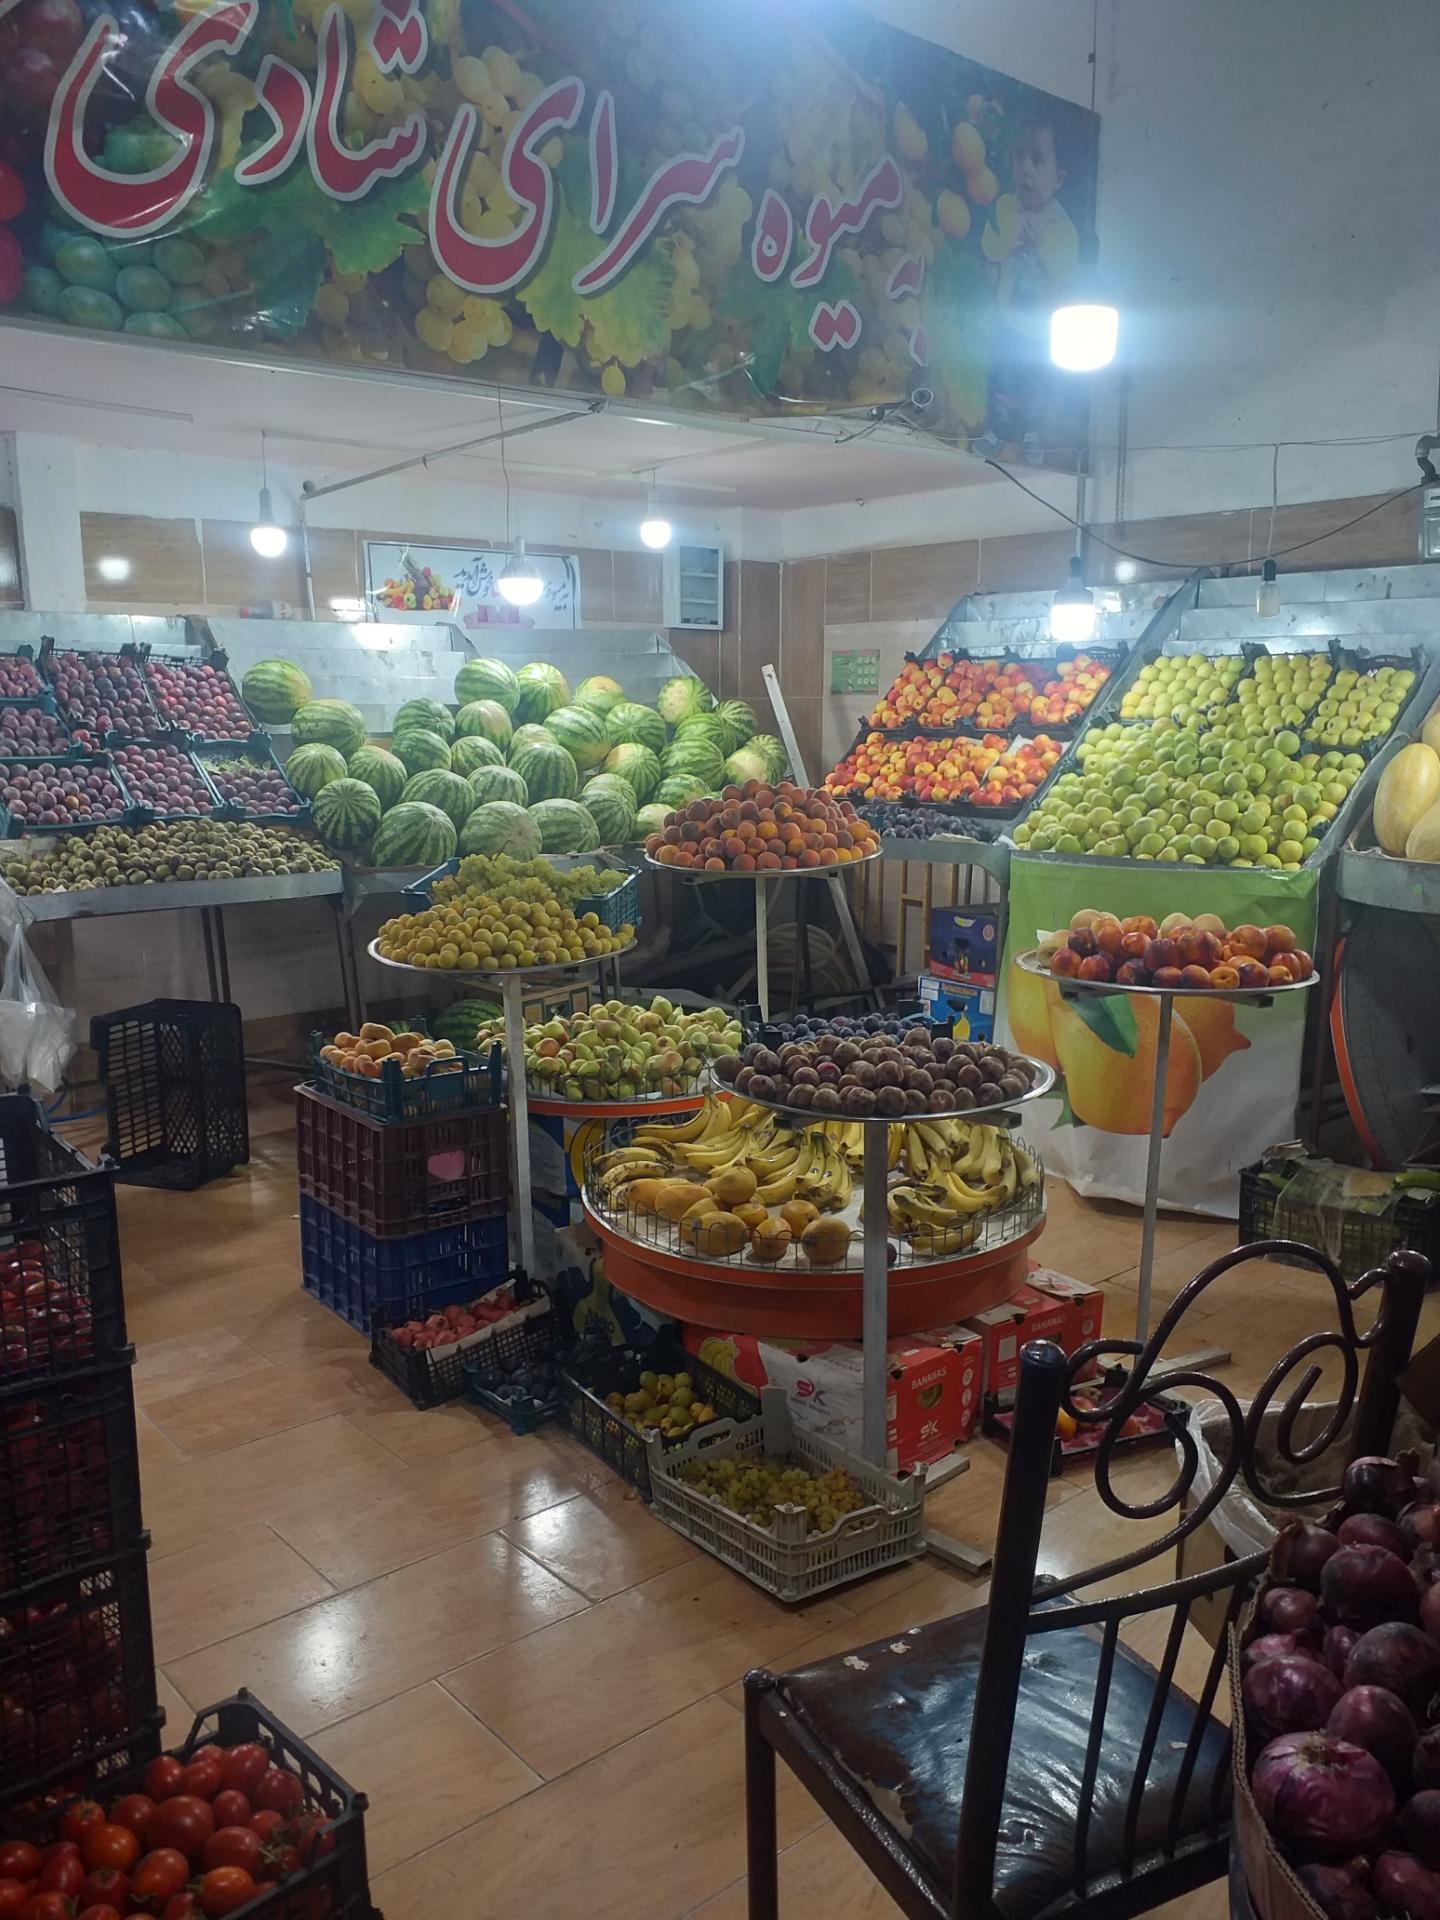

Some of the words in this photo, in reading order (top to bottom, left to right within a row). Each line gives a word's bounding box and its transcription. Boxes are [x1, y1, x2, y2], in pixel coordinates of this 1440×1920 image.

[44, 0, 428, 239] شادی
[428, 76, 745, 294] سرای
[751, 153, 902, 351] میوه
[911, 1366, 947, 1390] BANANAS
[1031, 1314, 1067, 1332] BANANAS
